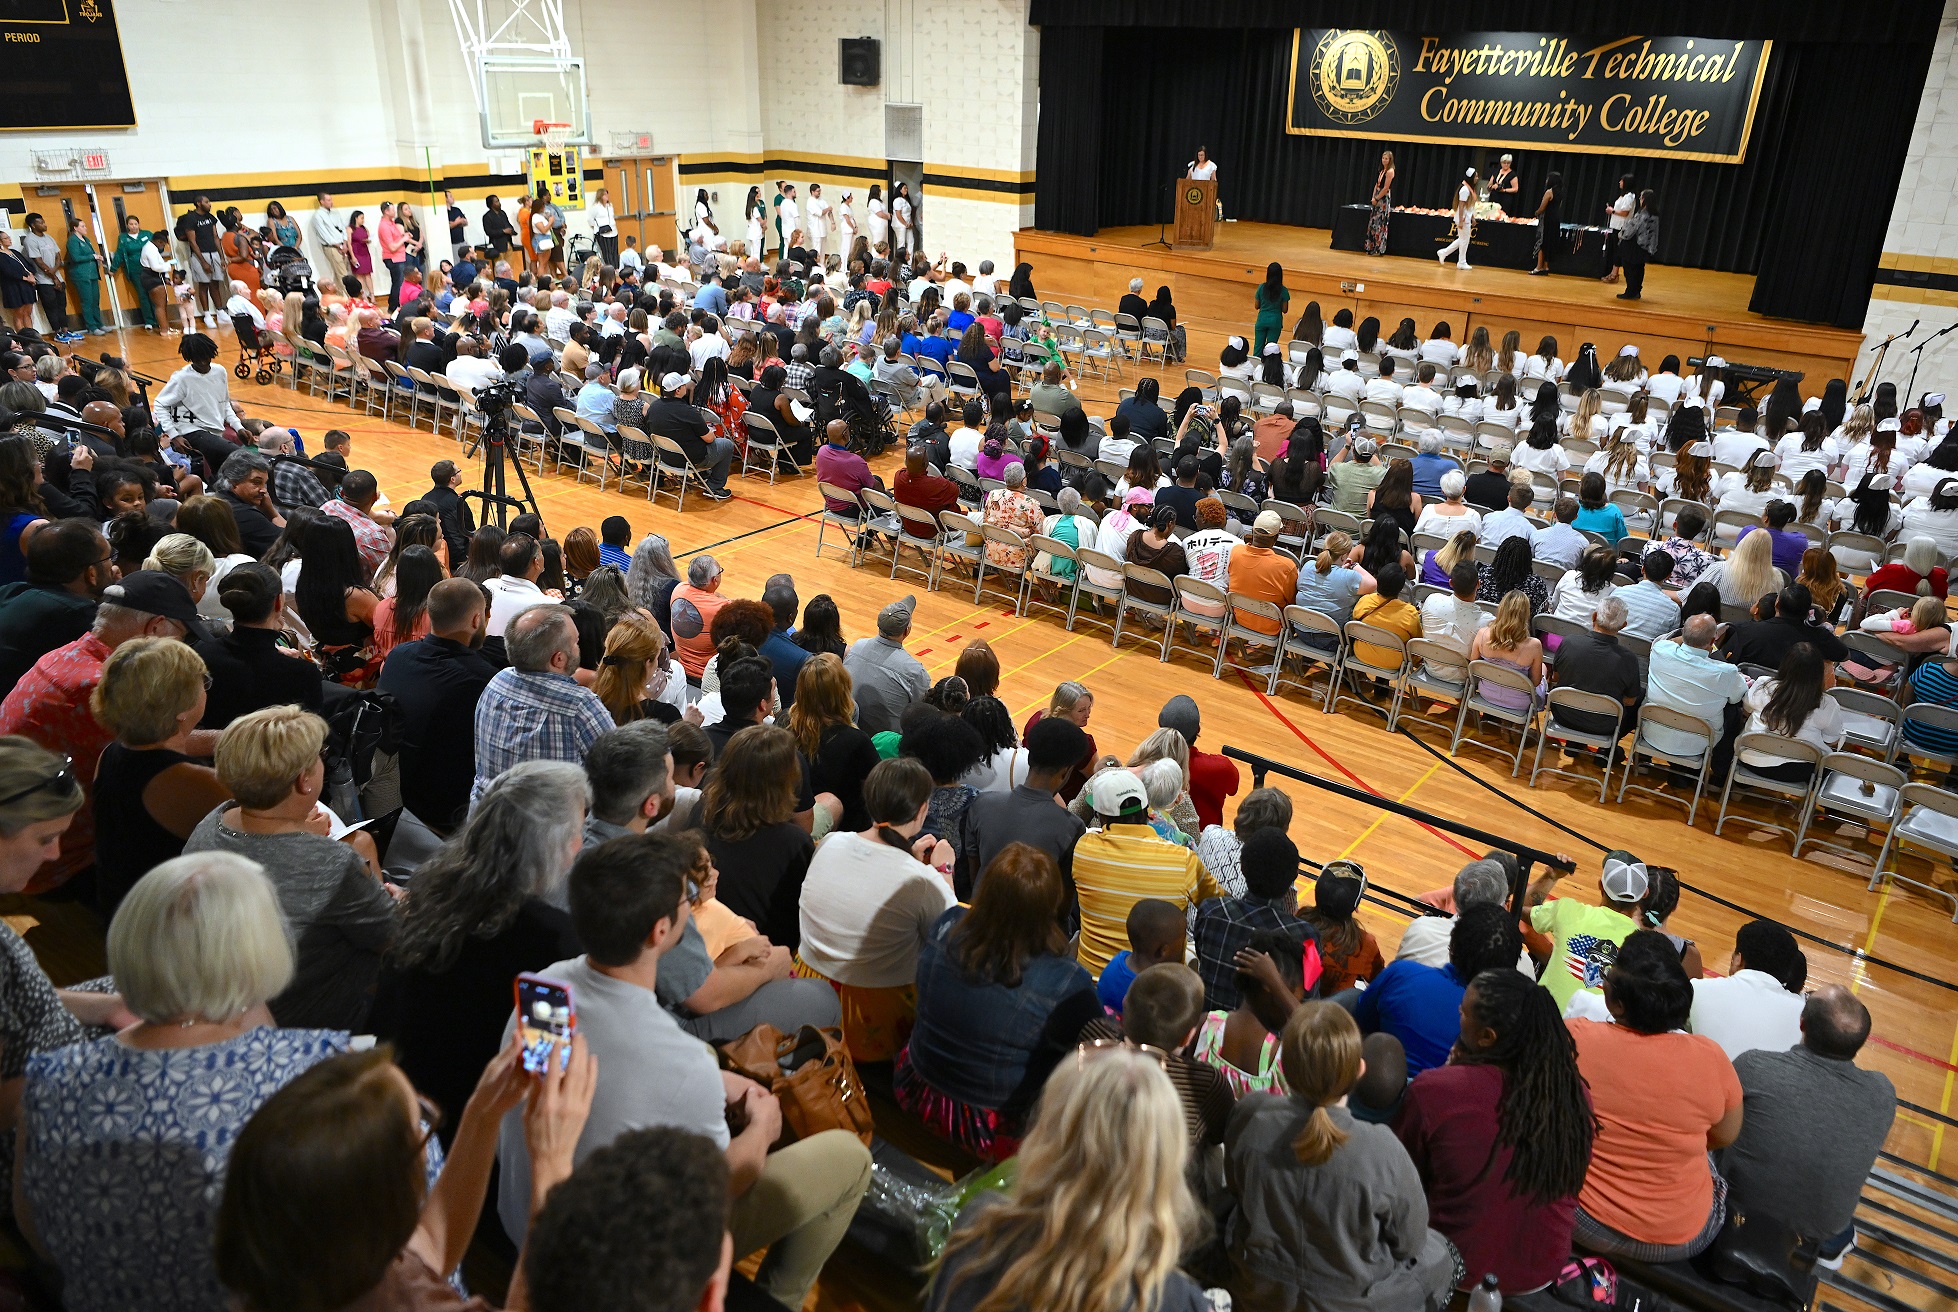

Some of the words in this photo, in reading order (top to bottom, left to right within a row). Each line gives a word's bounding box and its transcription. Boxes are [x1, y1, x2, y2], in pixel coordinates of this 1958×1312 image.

[4, 32, 41, 43] PERIOD
[1412, 37, 1578, 84] Fayetteville
[1580, 35, 1745, 83] Technical
[1420, 86, 1593, 141] Community
[1600, 93, 1710, 146] College
[86, 155, 104, 168] EXIT
[1187, 537, 1233, 549] ホリデー
